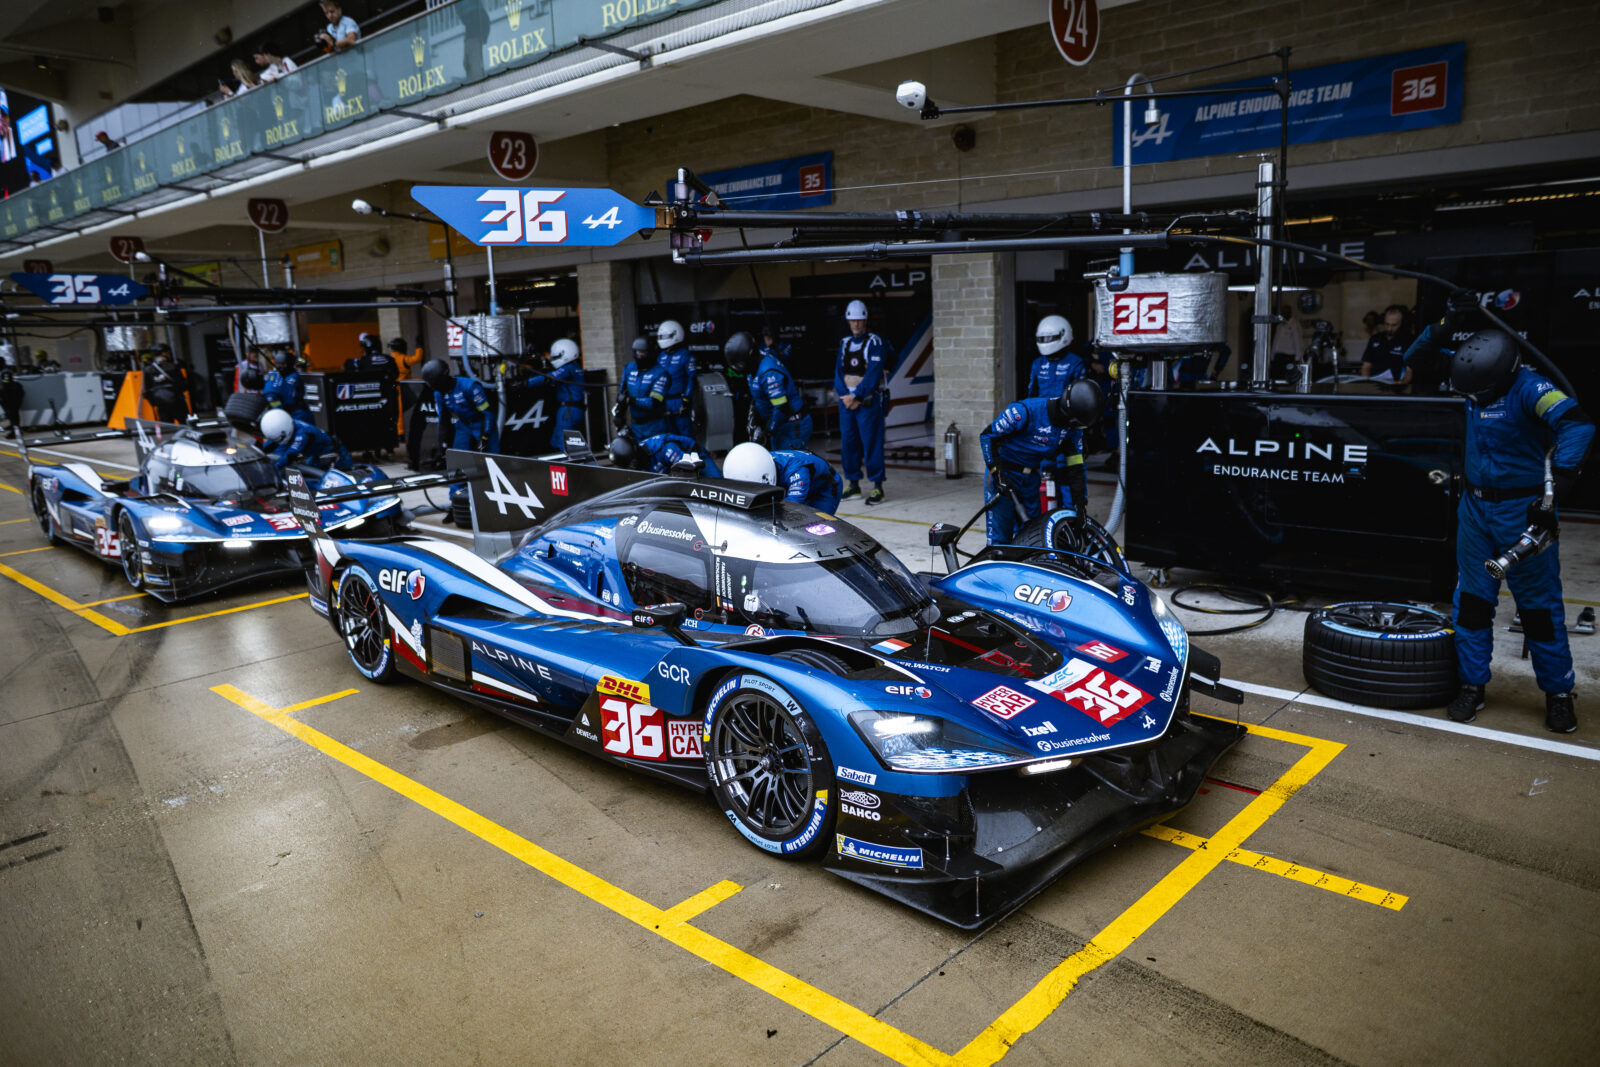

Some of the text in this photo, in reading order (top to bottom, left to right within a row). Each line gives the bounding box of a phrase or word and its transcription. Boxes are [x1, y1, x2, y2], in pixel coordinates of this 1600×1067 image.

[1063, 0, 1088, 47] 24
[488, 28, 547, 67] ROLEX
[398, 65, 446, 99] ROLEX
[1401, 76, 1437, 102] 36
[325, 95, 365, 124] ROLEX
[1194, 81, 1353, 123] ALPINE ENDURNCE TEAM
[265, 119, 299, 145] ROLEX
[214, 140, 244, 163] ROLEX
[500, 138, 526, 170] 23
[765, 172, 783, 188] TEAM
[804, 172, 821, 189] 35
[257, 203, 281, 225] 22
[476, 189, 569, 244] 36
[47, 274, 101, 303] 35
[1115, 296, 1168, 332] 36
[335, 402, 383, 412] McLaren
[1196, 437, 1368, 463] ALPINE
[551, 471, 566, 491] HY
[1213, 464, 1345, 484] ENDURANCE TEAM
[689, 487, 746, 506] ALPINE
[646, 523, 697, 542] businessolver
[378, 567, 408, 594] elf
[1014, 583, 1052, 606] elf
[1124, 591, 1135, 606] elf
[634, 615, 646, 623] elf
[472, 640, 553, 681] ALPINE
[1084, 642, 1119, 660] HY
[658, 661, 691, 686] GCR
[603, 676, 643, 700] DHL
[758, 680, 776, 693] SPORT
[885, 685, 915, 696] elf
[1063, 670, 1143, 722] 36
[706, 679, 737, 722] MICHELIN
[786, 700, 798, 712] W
[975, 688, 1014, 709] HYPER
[990, 694, 1032, 717] CAR
[601, 698, 664, 758] 36
[670, 723, 703, 736] HYPE
[1020, 720, 1059, 737] ixell
[672, 735, 703, 755] CA
[1050, 732, 1111, 750] businessolver
[840, 767, 873, 784] Sabelt
[841, 803, 881, 822] BAHCO
[785, 811, 822, 852] MICHELIN
[859, 847, 920, 863] MICHELIN
